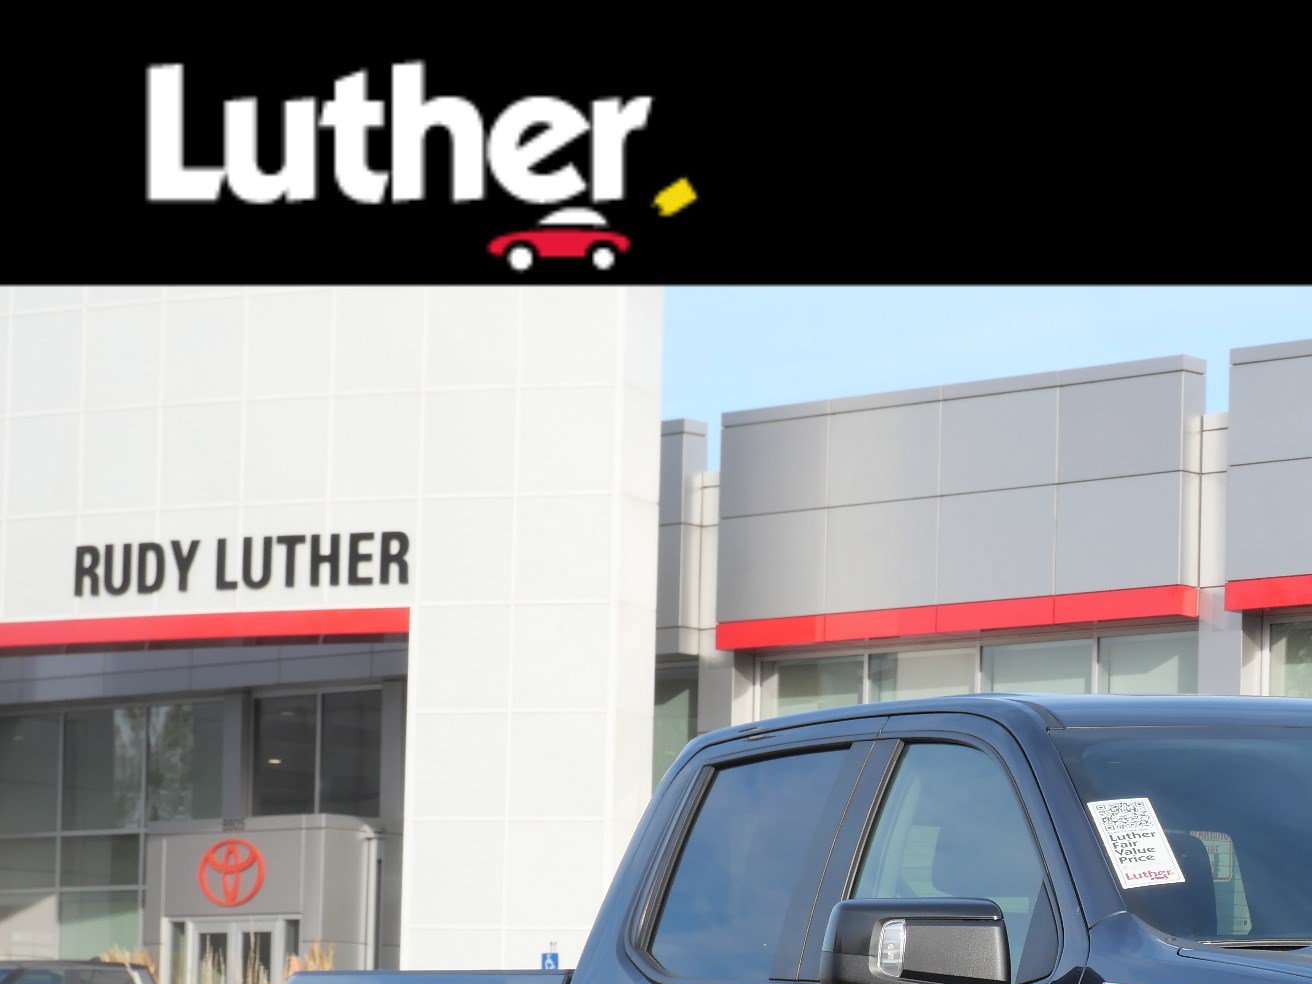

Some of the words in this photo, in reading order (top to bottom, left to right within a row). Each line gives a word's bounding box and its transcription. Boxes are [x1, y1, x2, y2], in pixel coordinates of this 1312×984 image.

[74, 540, 201, 597] RUDY
[215, 531, 410, 591] LUTHER
[1108, 831, 1156, 842] Luther
[1112, 841, 1138, 849] Fair
[1115, 846, 1156, 856] Value
[1119, 855, 1155, 864] Price
[1125, 869, 1172, 880] Luther
